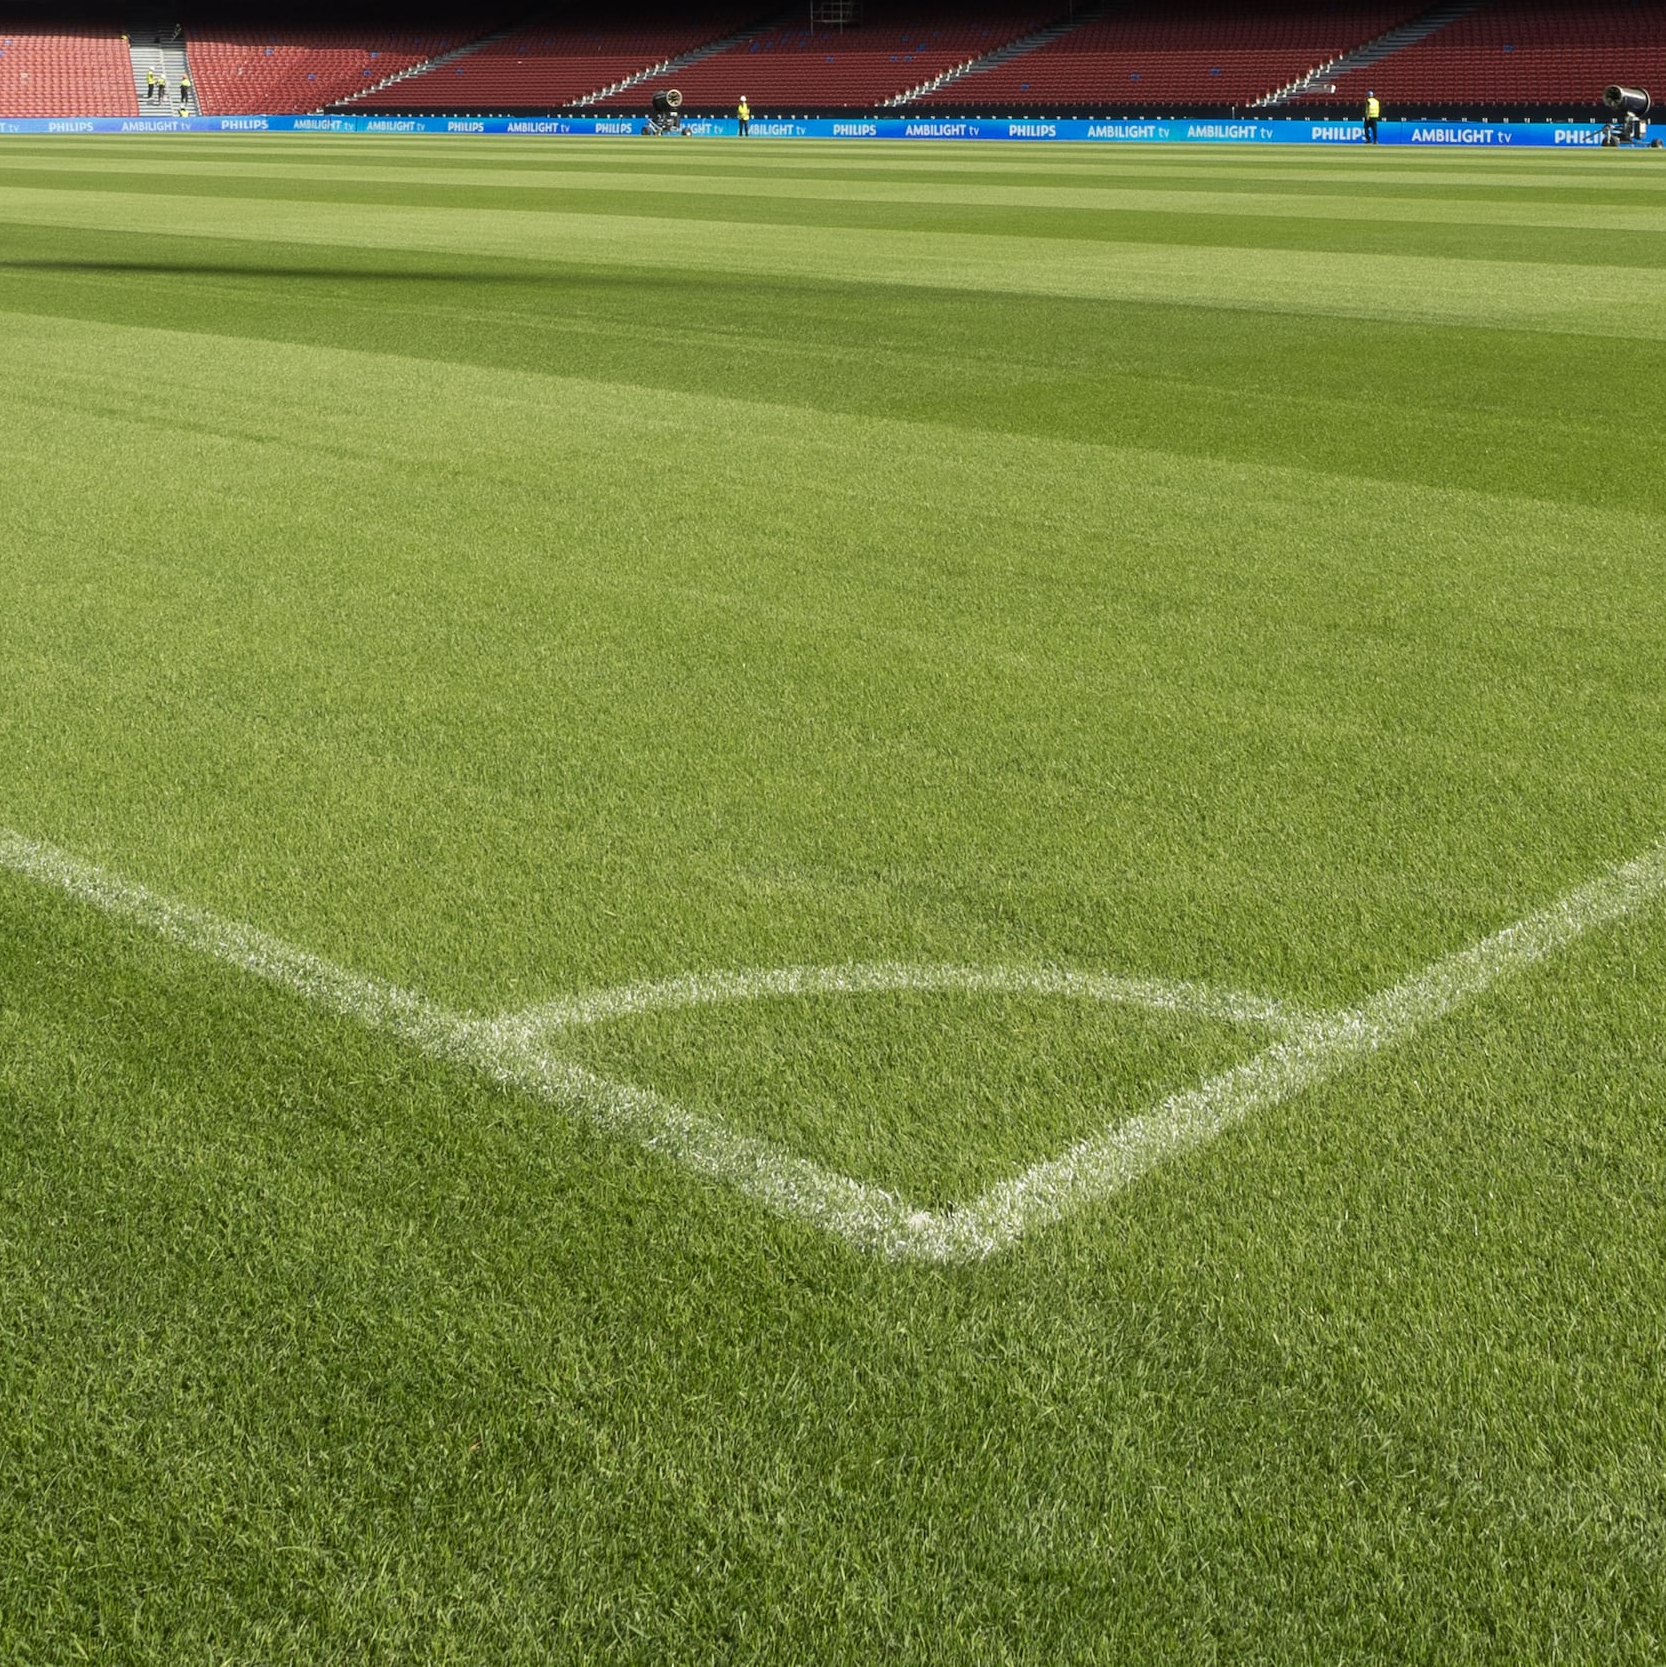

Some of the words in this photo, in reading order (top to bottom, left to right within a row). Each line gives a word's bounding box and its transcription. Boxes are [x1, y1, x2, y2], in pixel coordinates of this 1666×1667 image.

[9, 123, 20, 133] tv
[48, 121, 94, 132] PHILIPS
[122, 121, 178, 132] AMBILIGHT
[181, 122, 191, 132] tv
[221, 119, 269, 130] PHILIPS
[293, 119, 342, 130] AMBILIGHT
[366, 120, 415, 131] AMBILIGHT
[416, 121, 426, 131] tv
[447, 121, 484, 133] PHILIPS
[507, 122, 559, 133] AMBILIGHT
[560, 123, 570, 133] tv
[595, 122, 632, 133] PHILIPS
[714, 125, 724, 135] tv
[747, 123, 794, 135] MBILIGHT
[796, 125, 806, 135] tv
[834, 124, 877, 136] PHILIPS
[905, 124, 966, 136] AMBILIGHT
[969, 126, 980, 137] tv
[1009, 124, 1056, 137] PHILIPS
[1087, 126, 1155, 138] AMBILIGHT
[1158, 127, 1170, 138] tv
[1187, 126, 1257, 138] AMBILIGHT
[1261, 127, 1273, 139] tv
[1411, 130, 1493, 143] AMBILIGHT
[1497, 131, 1512, 143] tv
